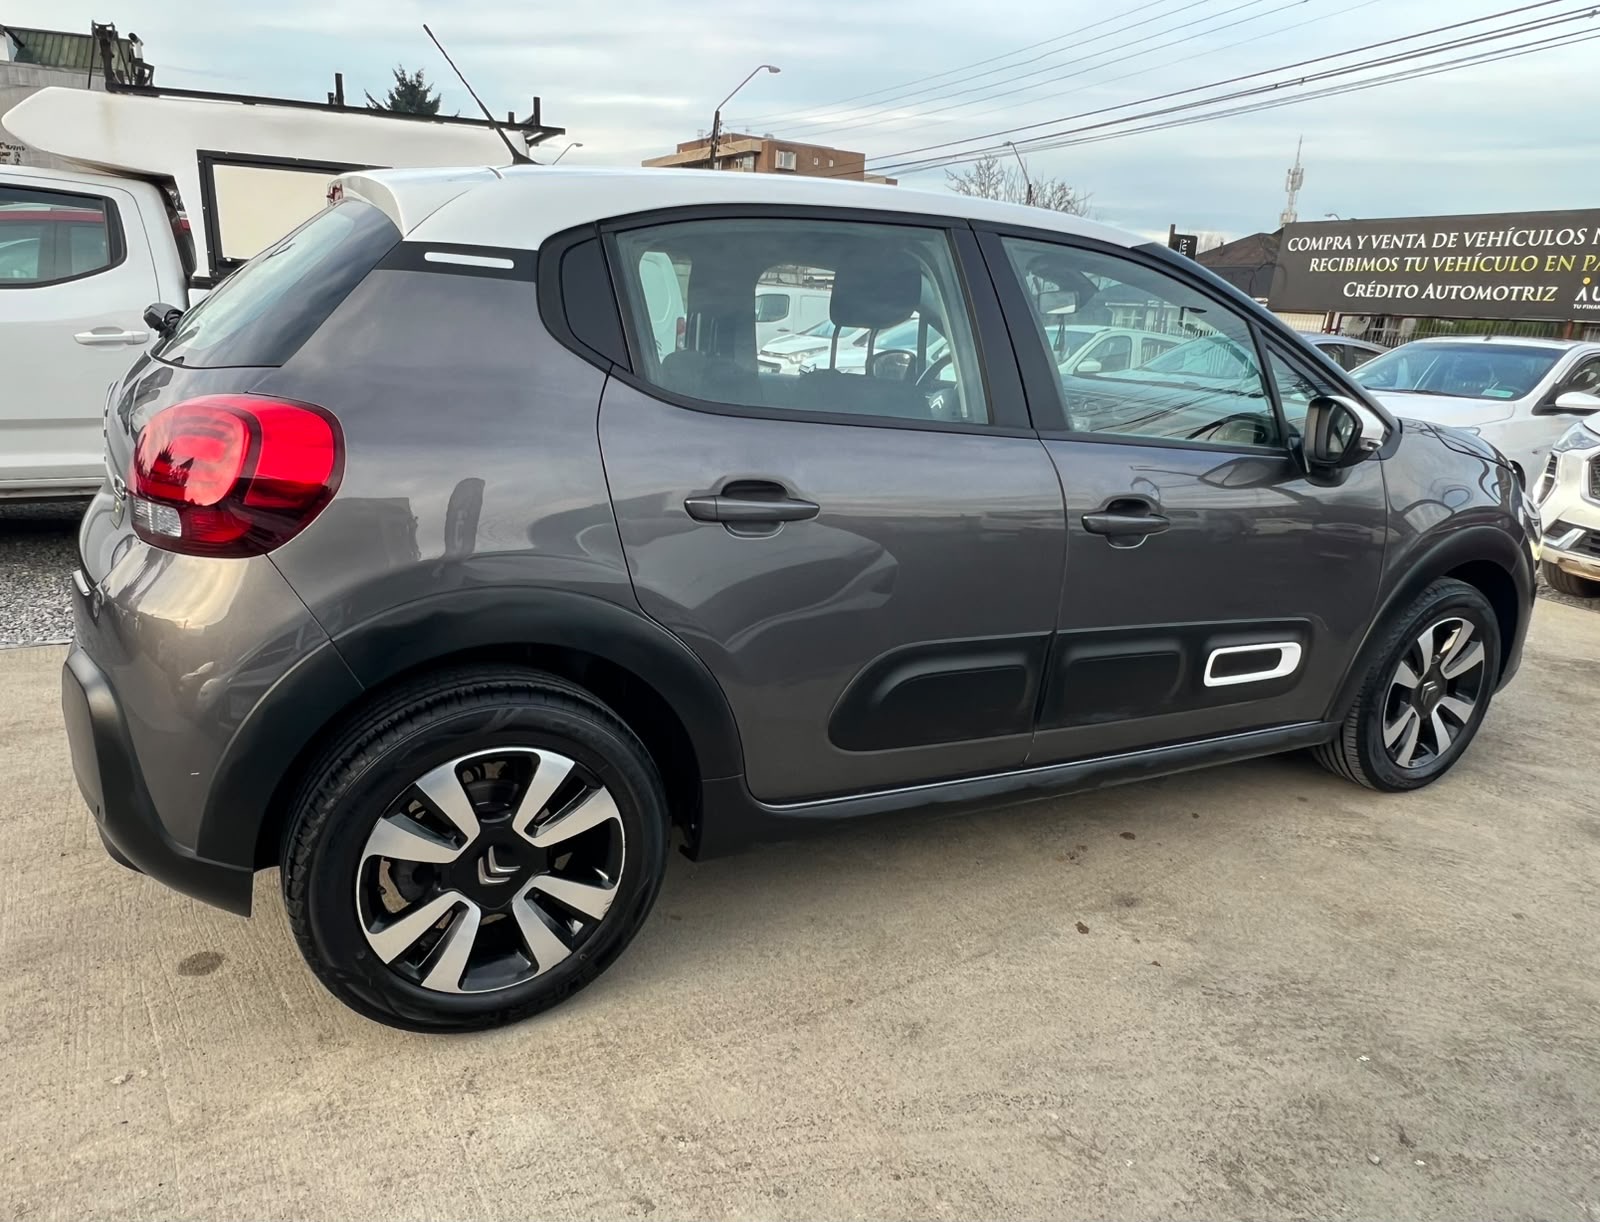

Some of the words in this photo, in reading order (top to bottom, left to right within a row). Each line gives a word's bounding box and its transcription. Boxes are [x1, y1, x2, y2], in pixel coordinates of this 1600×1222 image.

[1287, 235, 1352, 252] COMPRA
[1357, 235, 1368, 250] Y
[1371, 233, 1427, 249] VENTA
[1431, 232, 1459, 248] DE
[1463, 226, 1588, 248] VEHÍCULOS
[1309, 257, 1400, 272] RECIBIMOS
[1403, 256, 1429, 272] TU
[1433, 252, 1539, 272] VEHÍCULO
[1543, 254, 1577, 272] EN
[1343, 280, 1419, 299] CRÉDITO
[1421, 282, 1559, 302] AUTOMOTRIZ
